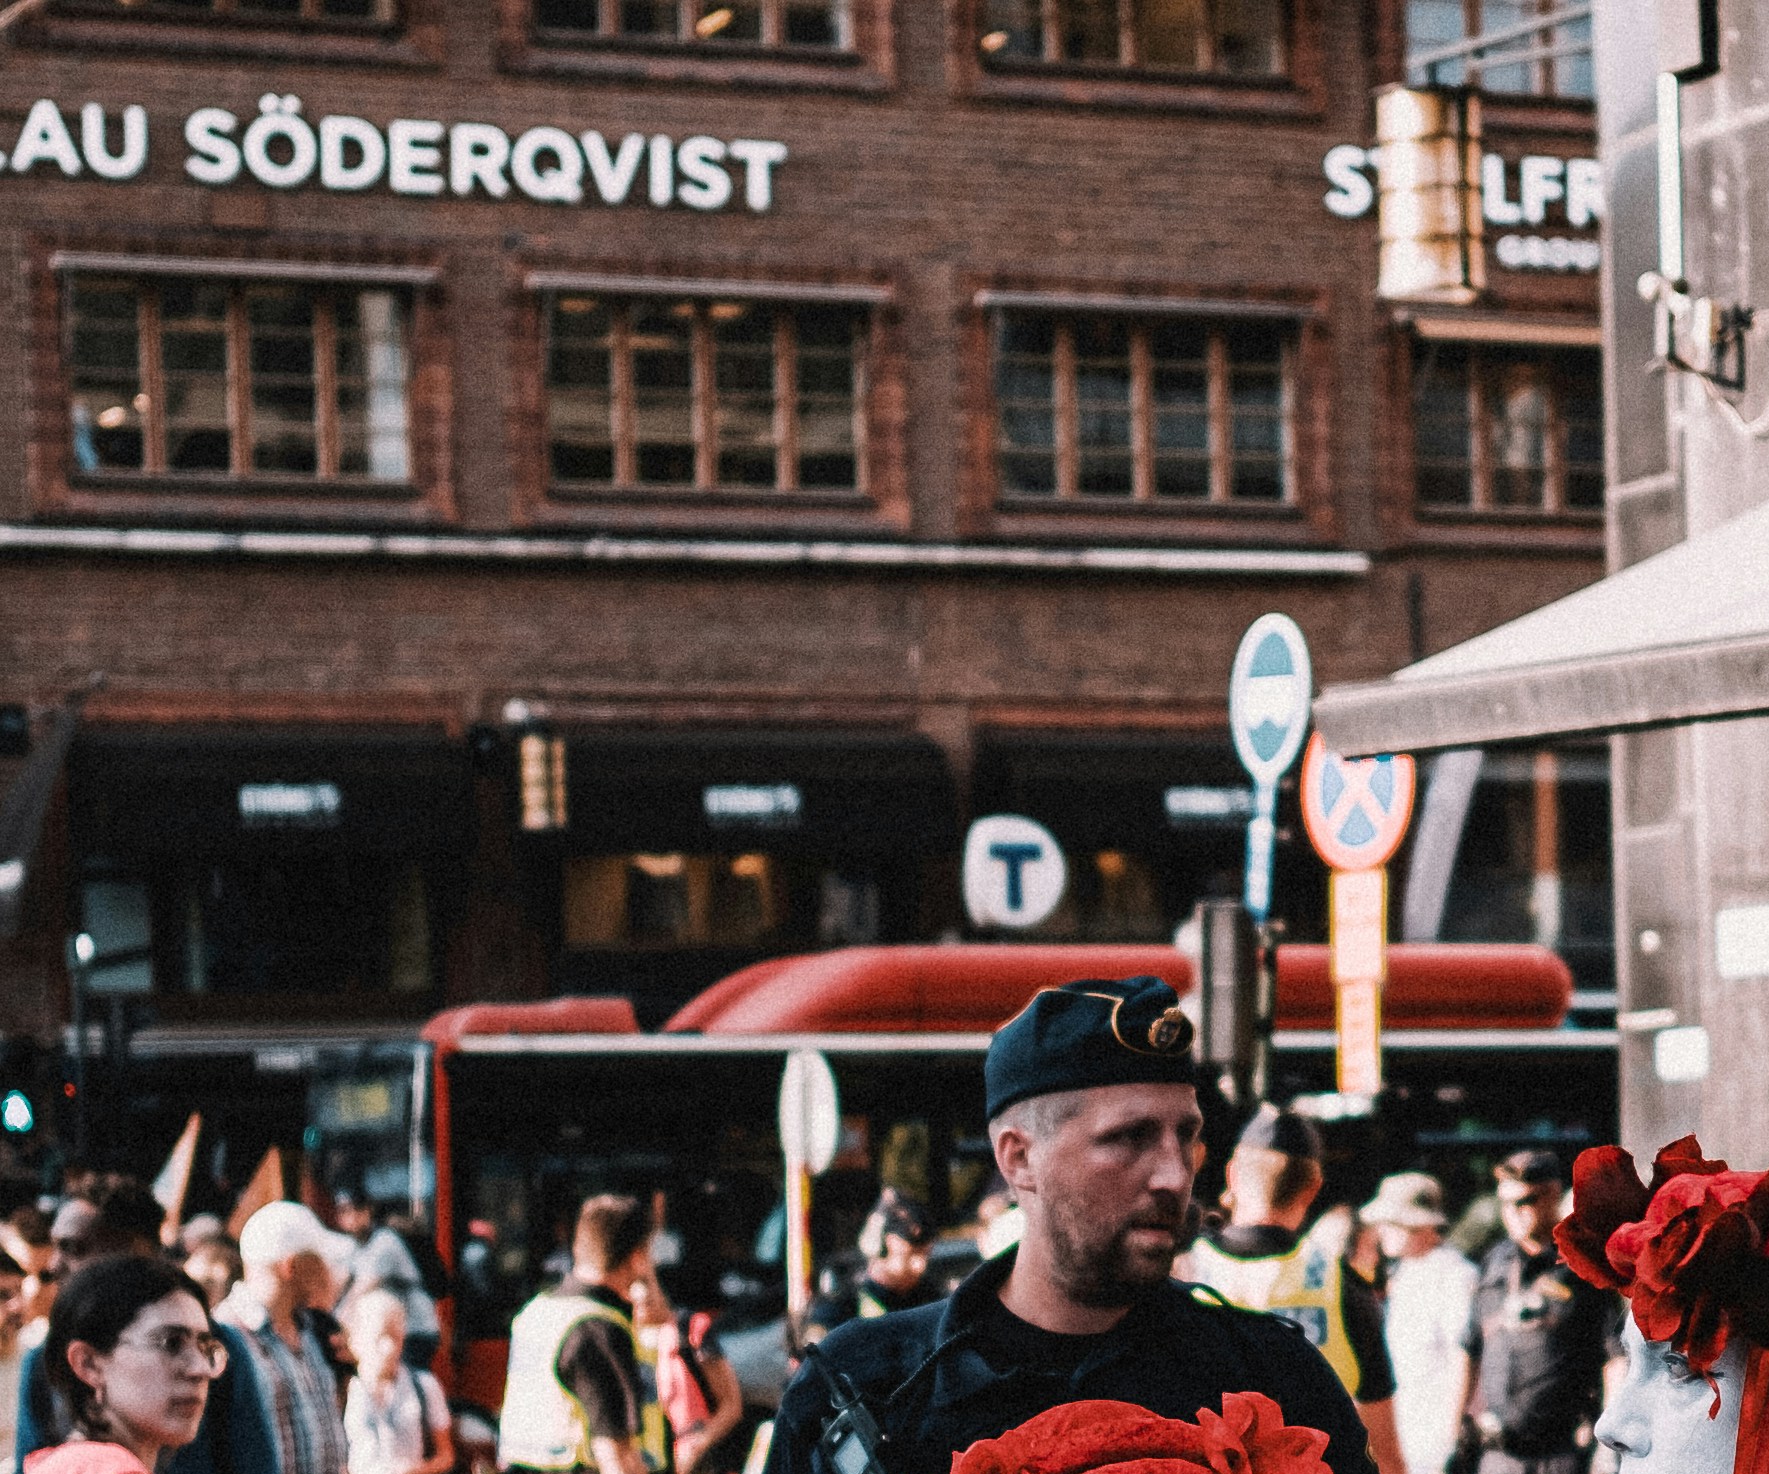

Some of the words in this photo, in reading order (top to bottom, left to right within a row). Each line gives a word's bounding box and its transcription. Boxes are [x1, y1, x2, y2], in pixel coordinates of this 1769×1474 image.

[0, 98, 148, 180] AU
[184, 93, 788, 212] SÖDERQVIST
[988, 842, 1043, 912] T
